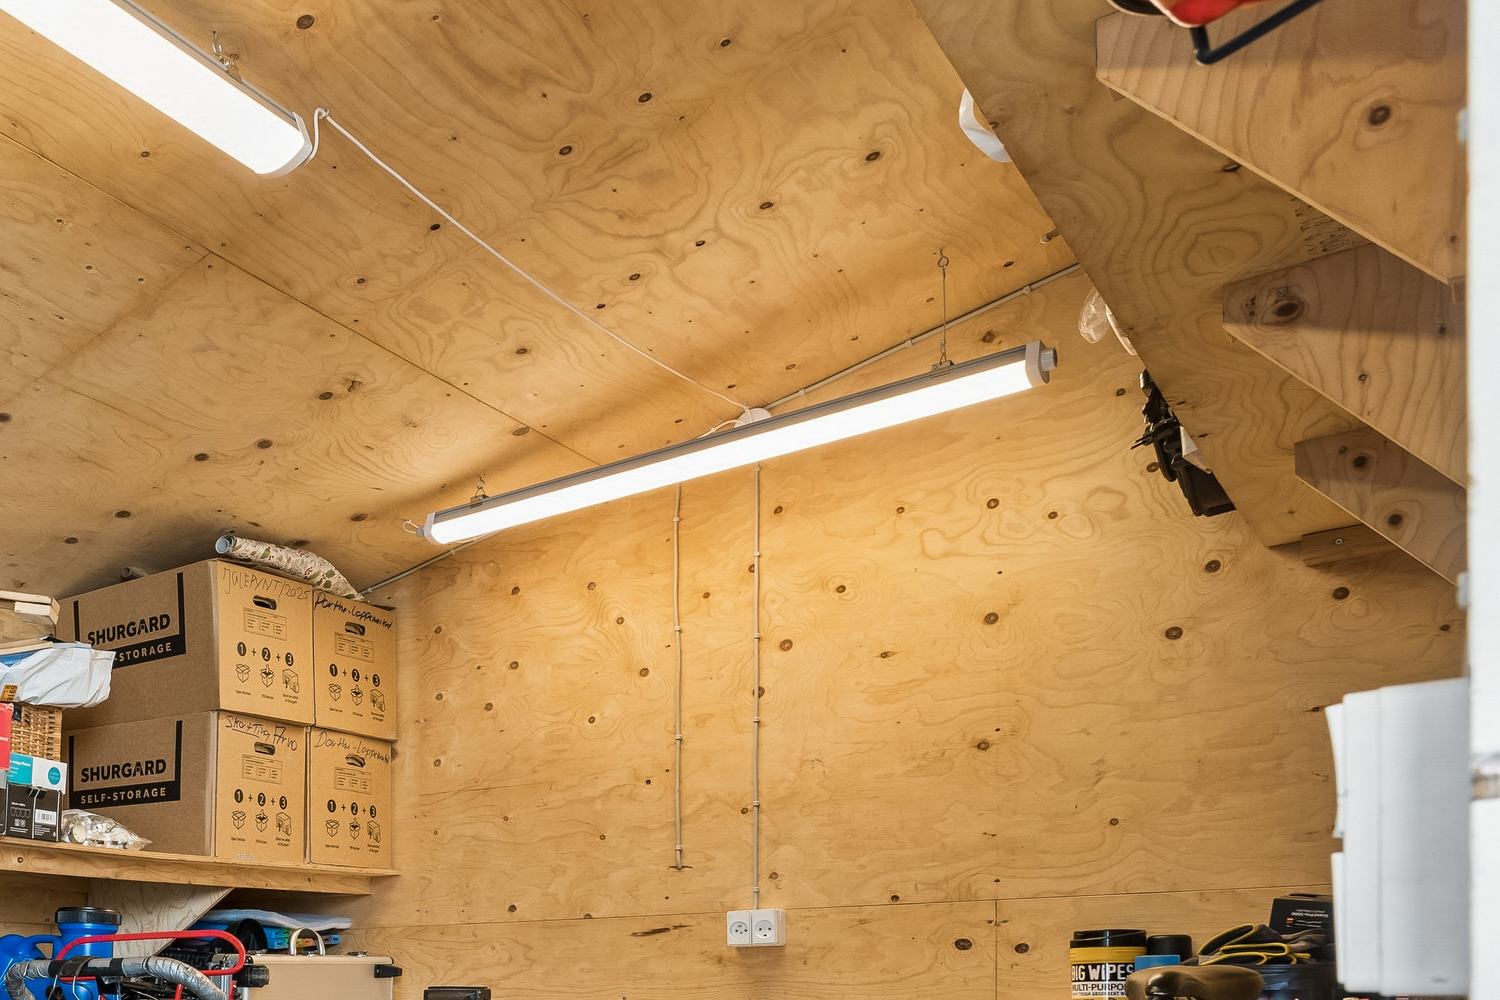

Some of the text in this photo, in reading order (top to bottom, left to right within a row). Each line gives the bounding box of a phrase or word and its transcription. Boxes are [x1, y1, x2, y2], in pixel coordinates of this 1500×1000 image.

[87, 613, 171, 647] SHURGARD
[113, 642, 172, 663] -STORAGE
[81, 758, 167, 783] SHURGARD
[81, 787, 166, 804] SELF-STORAGE
[1071, 964, 1086, 981] BIG
[1072, 983, 1126, 991] MULTI-PURPO
